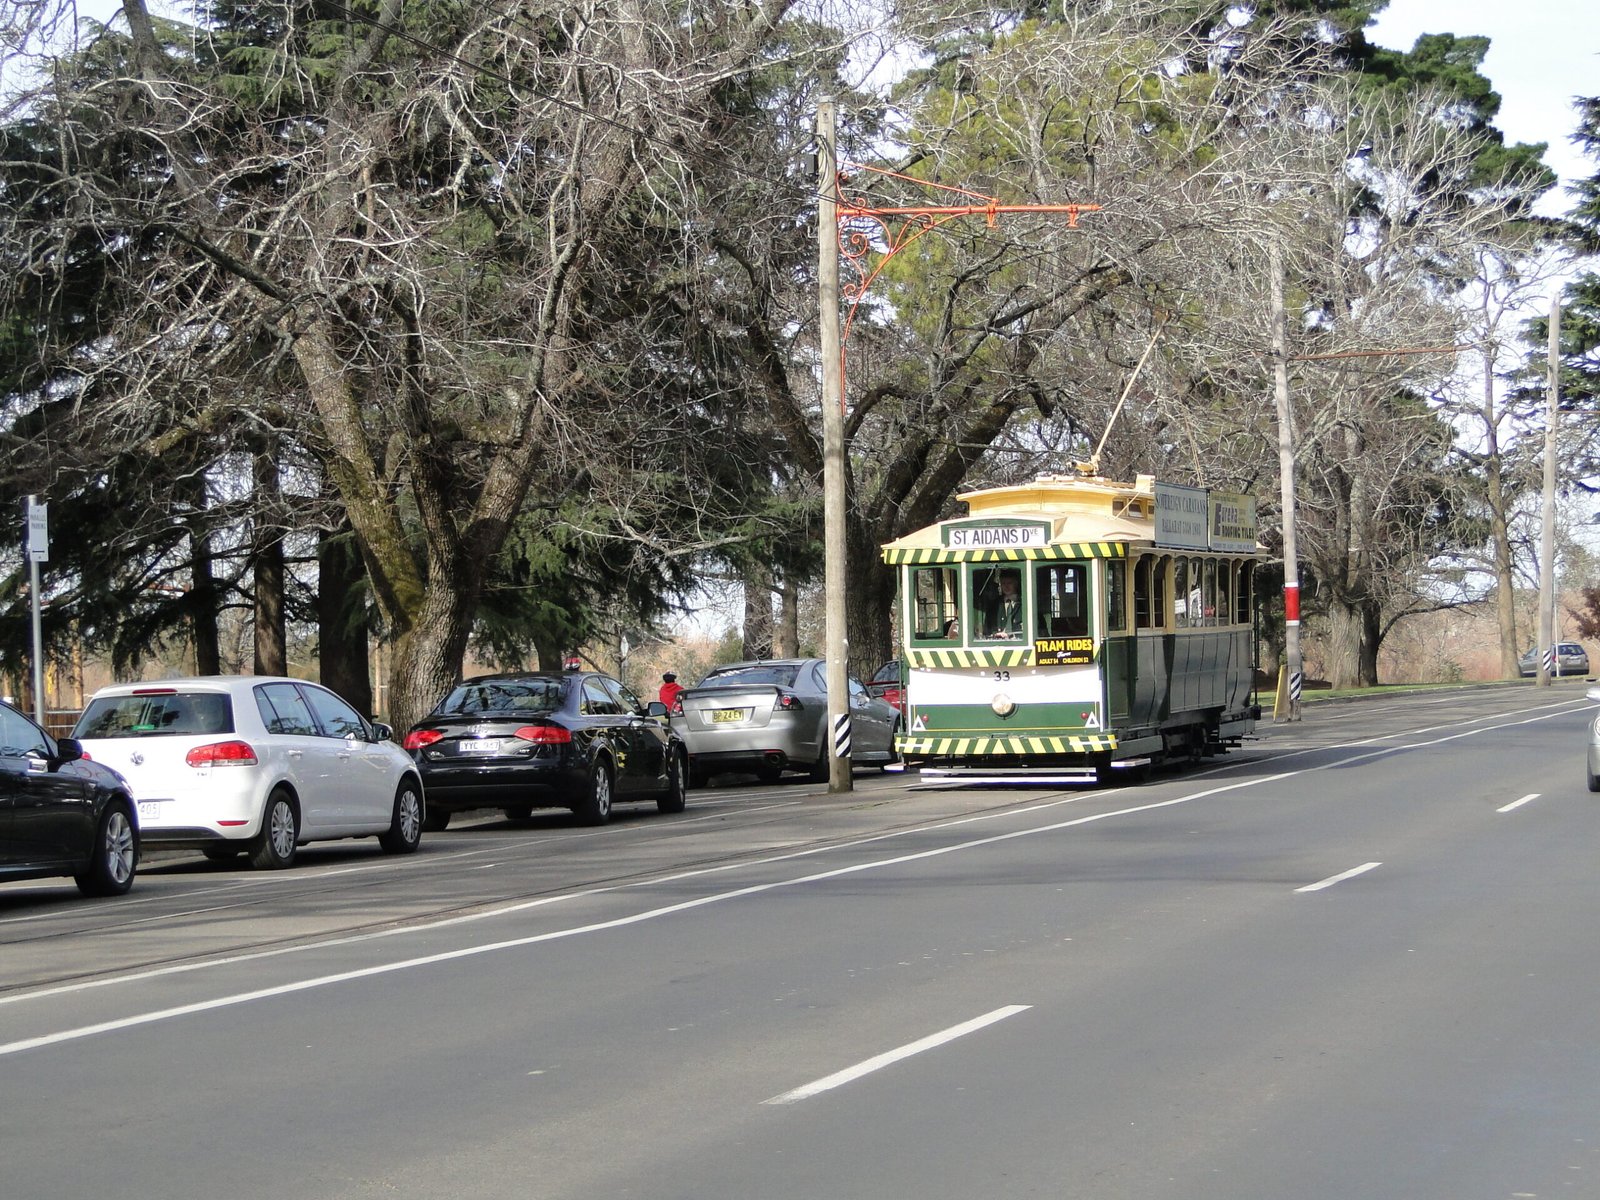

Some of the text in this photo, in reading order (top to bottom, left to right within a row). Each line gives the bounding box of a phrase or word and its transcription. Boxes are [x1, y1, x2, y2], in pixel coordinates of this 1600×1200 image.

[972, 528, 1018, 545] AIDANS
[1241, 527, 1254, 539] TILES
[1036, 639, 1092, 652] TRAM RIDES
[994, 671, 1010, 681] 33
